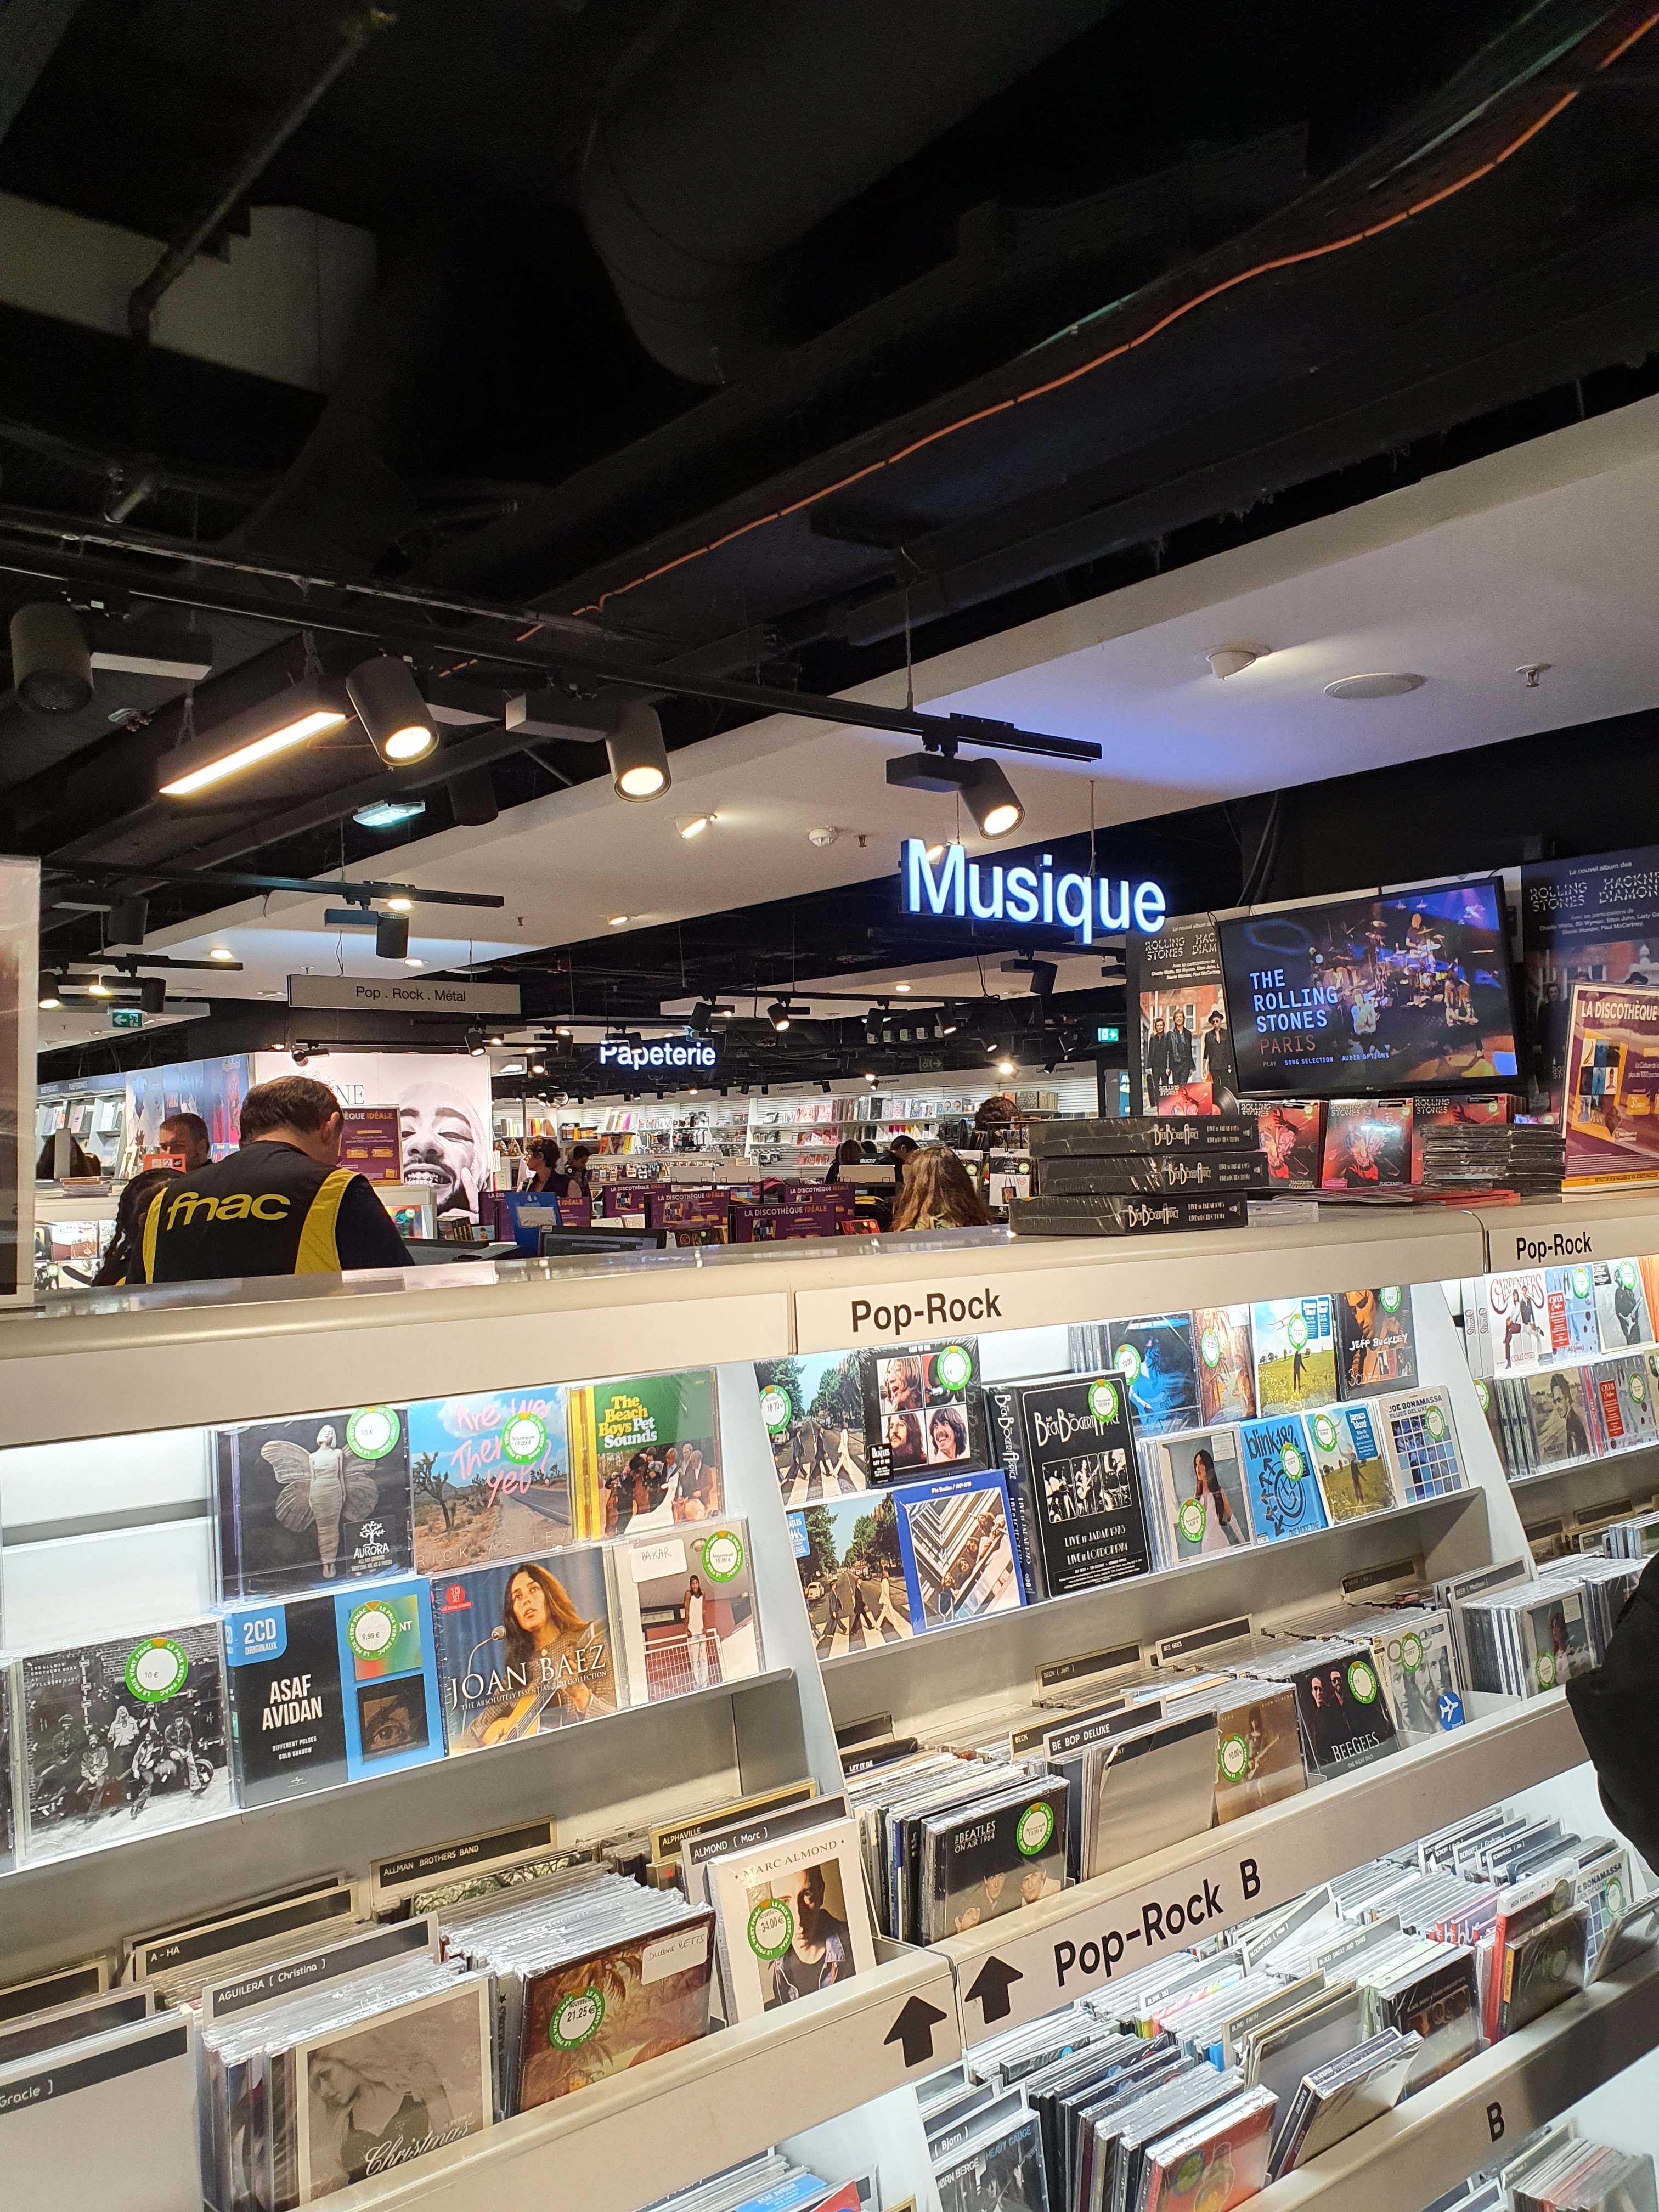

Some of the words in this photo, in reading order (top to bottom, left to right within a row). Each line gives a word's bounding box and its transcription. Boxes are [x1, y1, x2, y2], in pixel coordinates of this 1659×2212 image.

[1578, 866, 1598, 874] nouvel
[907, 838, 1166, 945] Musique
[1530, 882, 1588, 900] ROLLING
[1532, 895, 1585, 912] STONES
[1145, 936, 1186, 952] ROLLING
[1147, 947, 1183, 961] STONES
[1249, 968, 1285, 990] THE
[356, 986, 381, 999] Pop
[392, 987, 424, 1001] Rock
[435, 990, 466, 1002] Métal
[1253, 985, 1338, 1012] ROLLING
[1582, 1000, 1594, 1018] LA
[1595, 999, 1658, 1022] DISCOTHÈQUE
[1256, 1009, 1328, 1033] STONES
[1260, 1034, 1316, 1055] PARIS
[600, 1040, 716, 1070] Papeterie
[1301, 1056, 1334, 1065] SELECTION
[1362, 1052, 1390, 1060] OPTIONS
[1415, 1098, 1450, 1107] ROLLING
[1416, 1105, 1448, 1115] STONES
[366, 1111, 393, 1120] IDÉALE
[1331, 1109, 1361, 1117] STONES
[562, 1198, 583, 1206] IDÉALE
[666, 1192, 705, 1200] DISCOTHÈQUE
[167, 1192, 291, 1231] fnac
[754, 1206, 803, 1216] DISCOTHÈQUE
[804, 1204, 828, 1214] IDÉALE
[1516, 1231, 1592, 1263] Pop-Rock
[1490, 1273, 1545, 1315] CARPENTERS
[851, 1288, 1003, 1335] Pop-Rock
[1348, 1339, 1370, 1351] JEFF
[1372, 1333, 1408, 1347] BUCKLEY
[611, 1395, 640, 1409] The
[1388, 1403, 1401, 1413] JOE
[1402, 1395, 1443, 1409] BONAMASSA
[456, 1402, 501, 1431] Are
[604, 1404, 648, 1423] Beach
[1389, 1409, 1407, 1419] BLUES
[598, 1421, 633, 1437] Boys
[632, 1416, 656, 1432] Pet
[604, 1429, 658, 1449] Sounds
[871, 1447, 890, 1459] BEATLES
[1064, 1535, 1081, 1548] LIVE
[1110, 1524, 1126, 1537] 1973
[353, 1542, 390, 1560] AURORA
[416, 1547, 468, 1567] RICK
[488, 1529, 568, 1553] ASTLEY
[641, 1547, 672, 1562] BAKAR
[1066, 1553, 1081, 1565] LIVE
[1114, 1542, 1128, 1553] 1974
[353, 1608, 367, 1622] FNAC
[386, 1610, 396, 1624] PRIX
[243, 1618, 276, 1645] 2CD
[174, 1647, 184, 1664] PRIX
[245, 1641, 278, 1655] ORIGINAUX
[351, 1640, 363, 1654] PRIX
[377, 1641, 392, 1656] FNAC
[1163, 1644, 1171, 1652] BEE
[129, 1678, 143, 1695] PRIX
[136, 1644, 152, 1658] FNAC
[451, 1662, 528, 1711] JOAN
[539, 1644, 606, 1683] BAEZ
[1043, 1669, 1056, 1678] BECK
[160, 1683, 178, 1697] FNAC
[270, 1674, 311, 1704] ASAF
[460, 1700, 475, 1711] THE
[476, 1692, 517, 1707] ABSOLUTELY
[517, 1684, 550, 1698] ESSENTIAL
[567, 1671, 607, 1685] COLLECTION
[262, 1696, 323, 1731] AVIDAN
[272, 1739, 298, 1752] DIFFERENT
[299, 1736, 317, 1745] PULSES
[1015, 1733, 1029, 1744] BECK
[1052, 1740, 1062, 1752] BE
[1064, 1734, 1080, 1747] BOP
[1083, 1724, 1110, 1740] DELUXE
[279, 1750, 291, 1760] GOLD
[292, 1747, 312, 1757] SHADOW
[849, 1764, 860, 1772] LET
[662, 1827, 702, 1847] ALPHAVILLE
[959, 1820, 996, 1842] BEATLES
[693, 1841, 728, 1859] ALMOND
[741, 1831, 760, 1844] Marc
[955, 1844, 965, 1854] ON
[967, 1839, 978, 1850] AIR
[980, 1832, 995, 1845] 1964
[1459, 1844, 1478, 1860] BONNET
[383, 1861, 414, 1876] ALLMAN
[419, 1850, 456, 1867] BROTHERS
[459, 1844, 479, 1857] BAND
[743, 1859, 782, 1878] MARC
[784, 1840, 838, 1865] ALMOND
[1493, 1847, 1513, 1861] BONAMASSA
[1582, 1862, 1622, 1889] BONAMASSA
[1053, 1878, 1224, 1988] Pop-Rock
[1240, 1857, 1261, 1900] B
[150, 1953, 157, 1962] A
[166, 1946, 180, 1957] HA
[1319, 1955, 1331, 1966] BLOOD
[218, 1979, 264, 2003] AGUILERA
[1147, 1994, 1160, 2004] BLINK
[1232, 2021, 1244, 2032] BLIND
[1246, 2012, 1259, 2024] FAITH
[1486, 2101, 1506, 2144] B
[365, 2119, 476, 2176] Christmas
[941, 2132, 962, 2151] Bjorn
[985, 2140, 1006, 2161] HEAVY
[1008, 2125, 1032, 2147] GAUGE
[955, 2157, 979, 2179] BERGE
